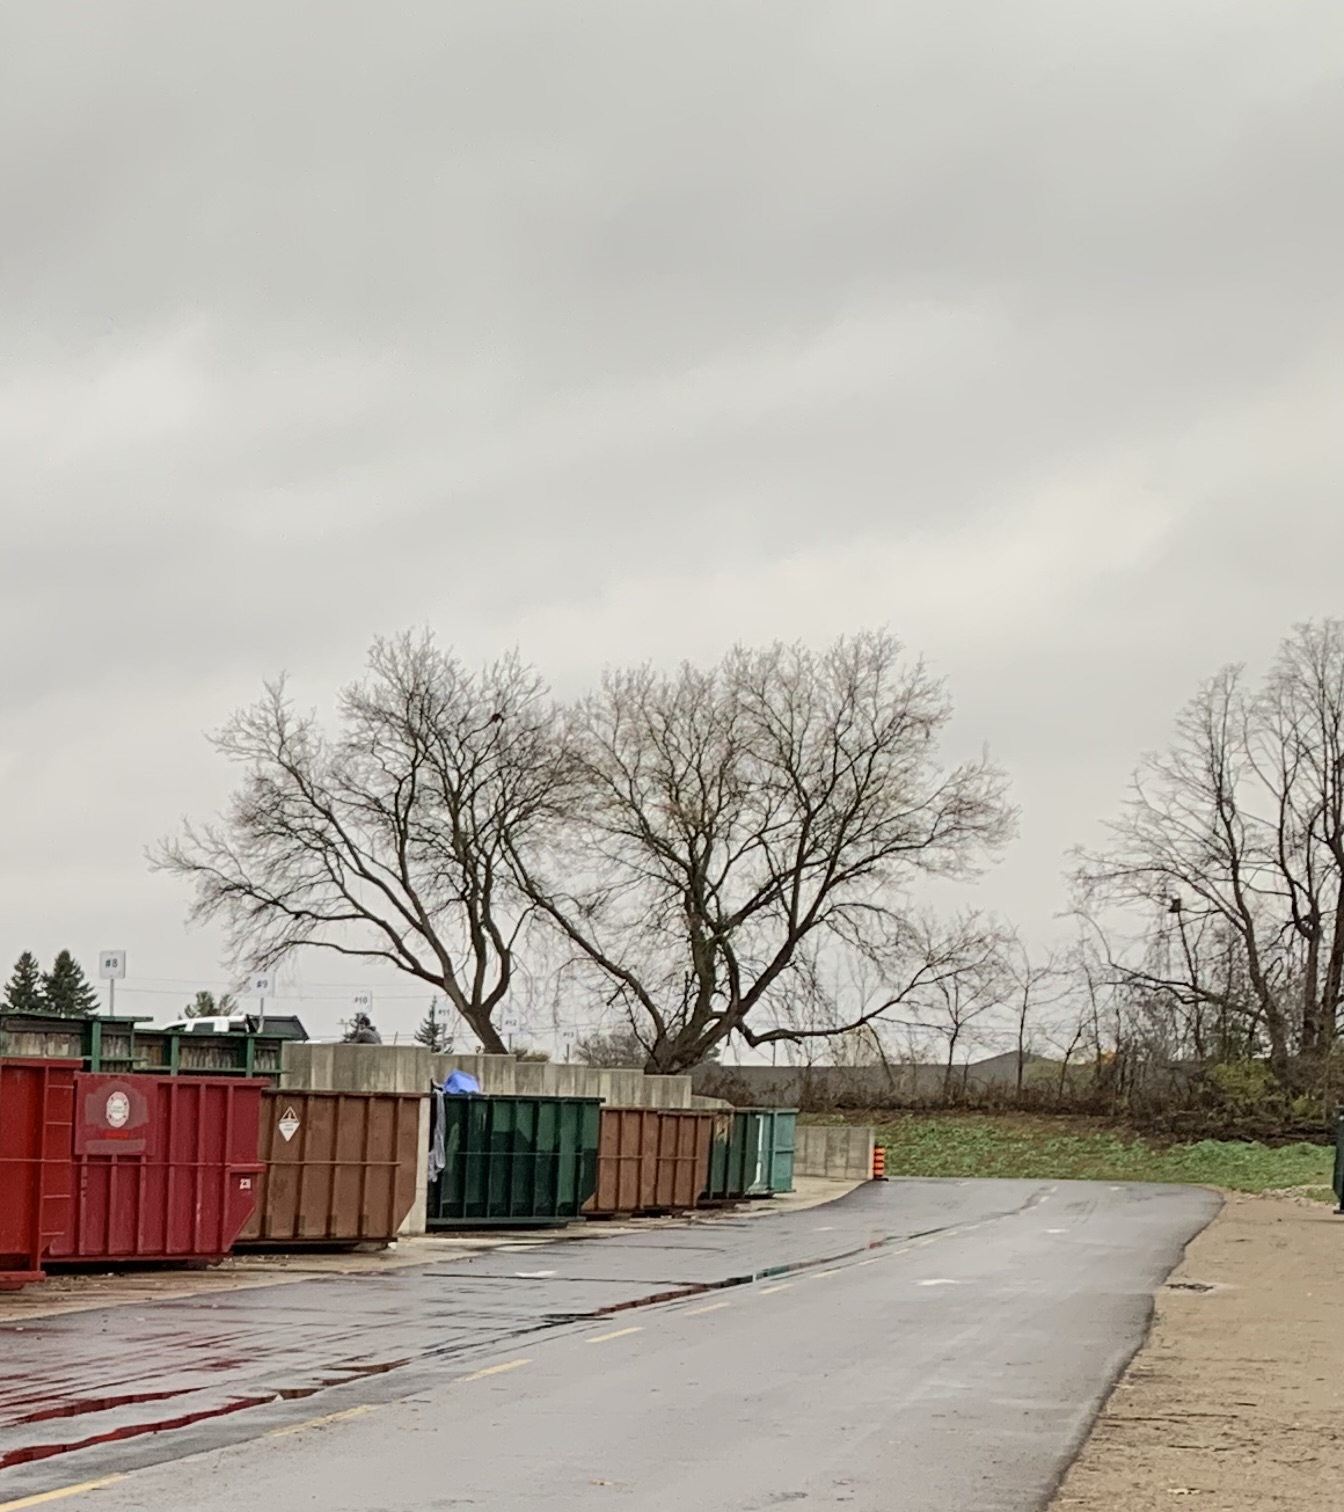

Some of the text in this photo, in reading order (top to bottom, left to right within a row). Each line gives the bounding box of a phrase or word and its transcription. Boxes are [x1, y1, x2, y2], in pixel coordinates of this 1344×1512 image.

[105, 958, 118, 969] #8
[257, 980, 268, 989] #9
[354, 996, 368, 1005] #10
